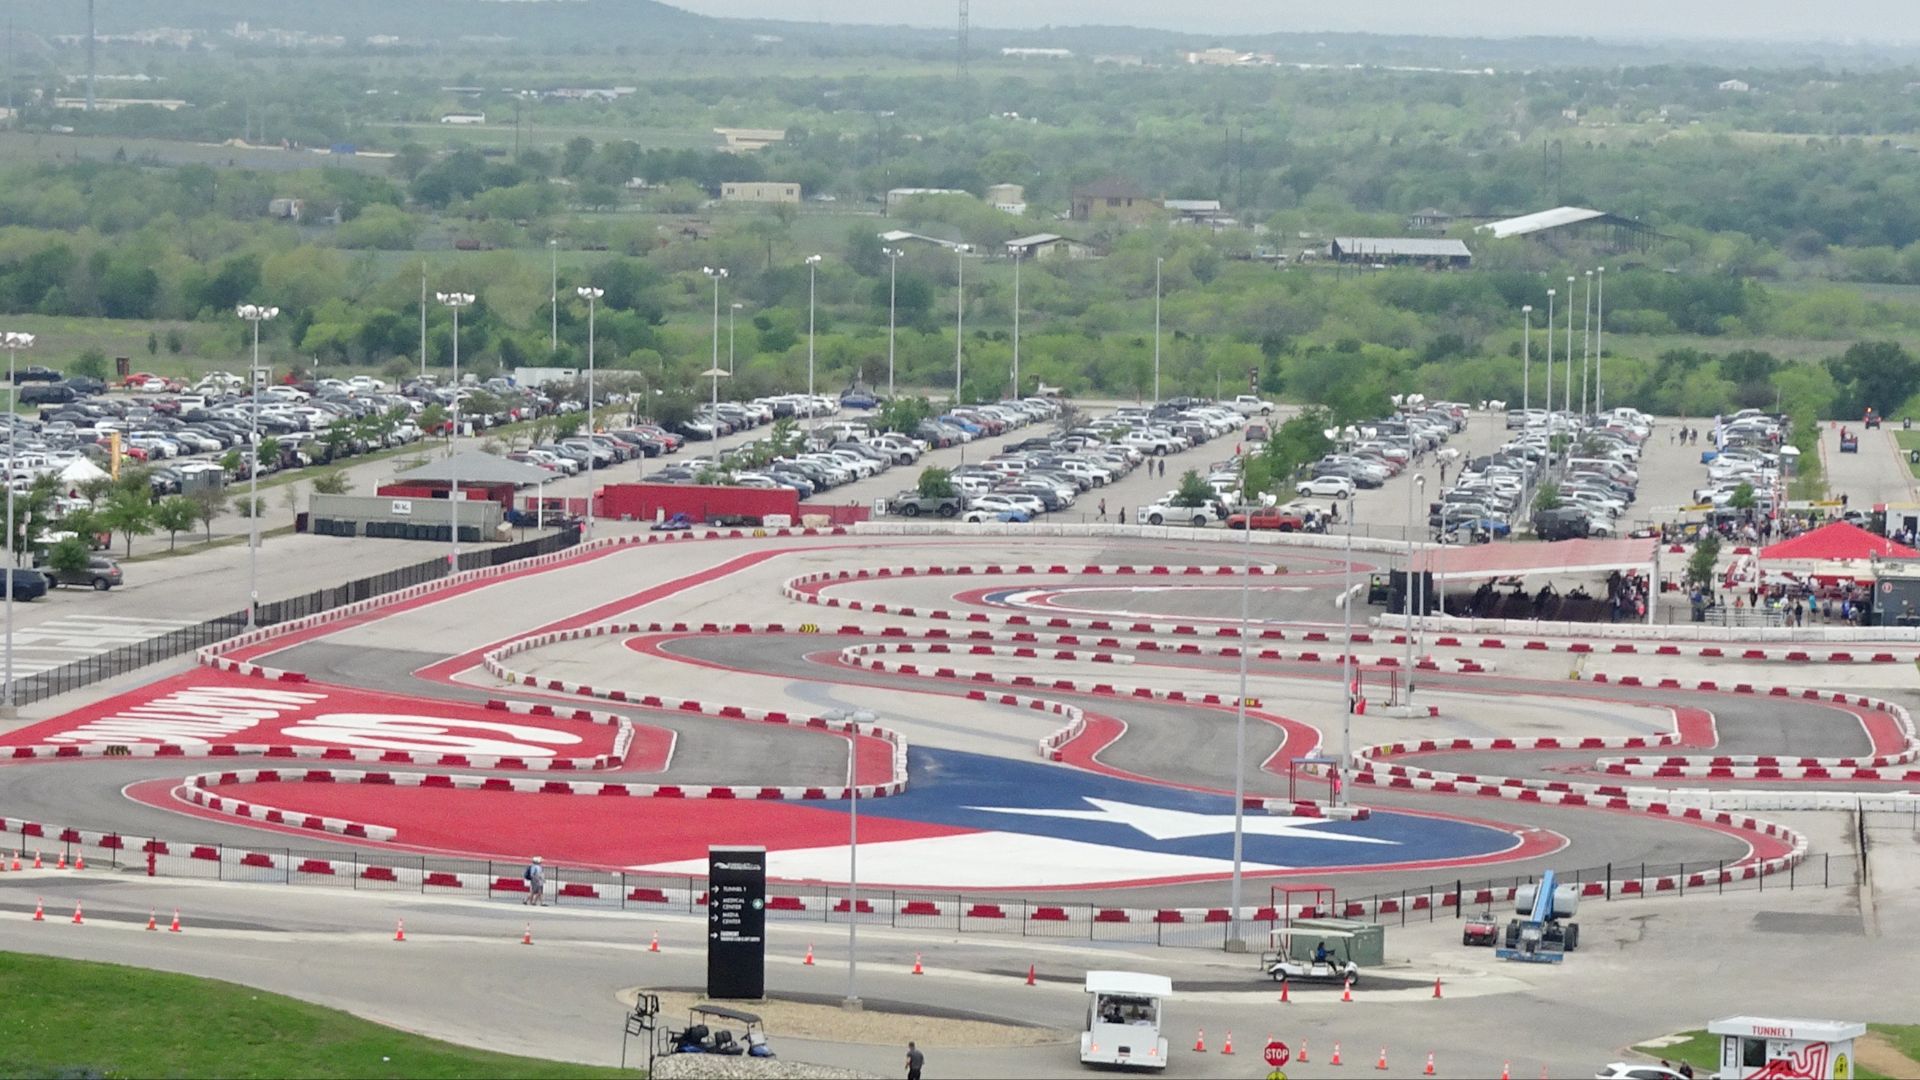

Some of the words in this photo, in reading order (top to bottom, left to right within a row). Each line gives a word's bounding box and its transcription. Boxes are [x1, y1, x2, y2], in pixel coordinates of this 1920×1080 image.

[43, 687, 328, 744] KARTING
[1752, 1025, 1787, 1037] TUNNEL
[1788, 1028, 1793, 1037] 1
[1265, 1048, 1289, 1060] STOP
